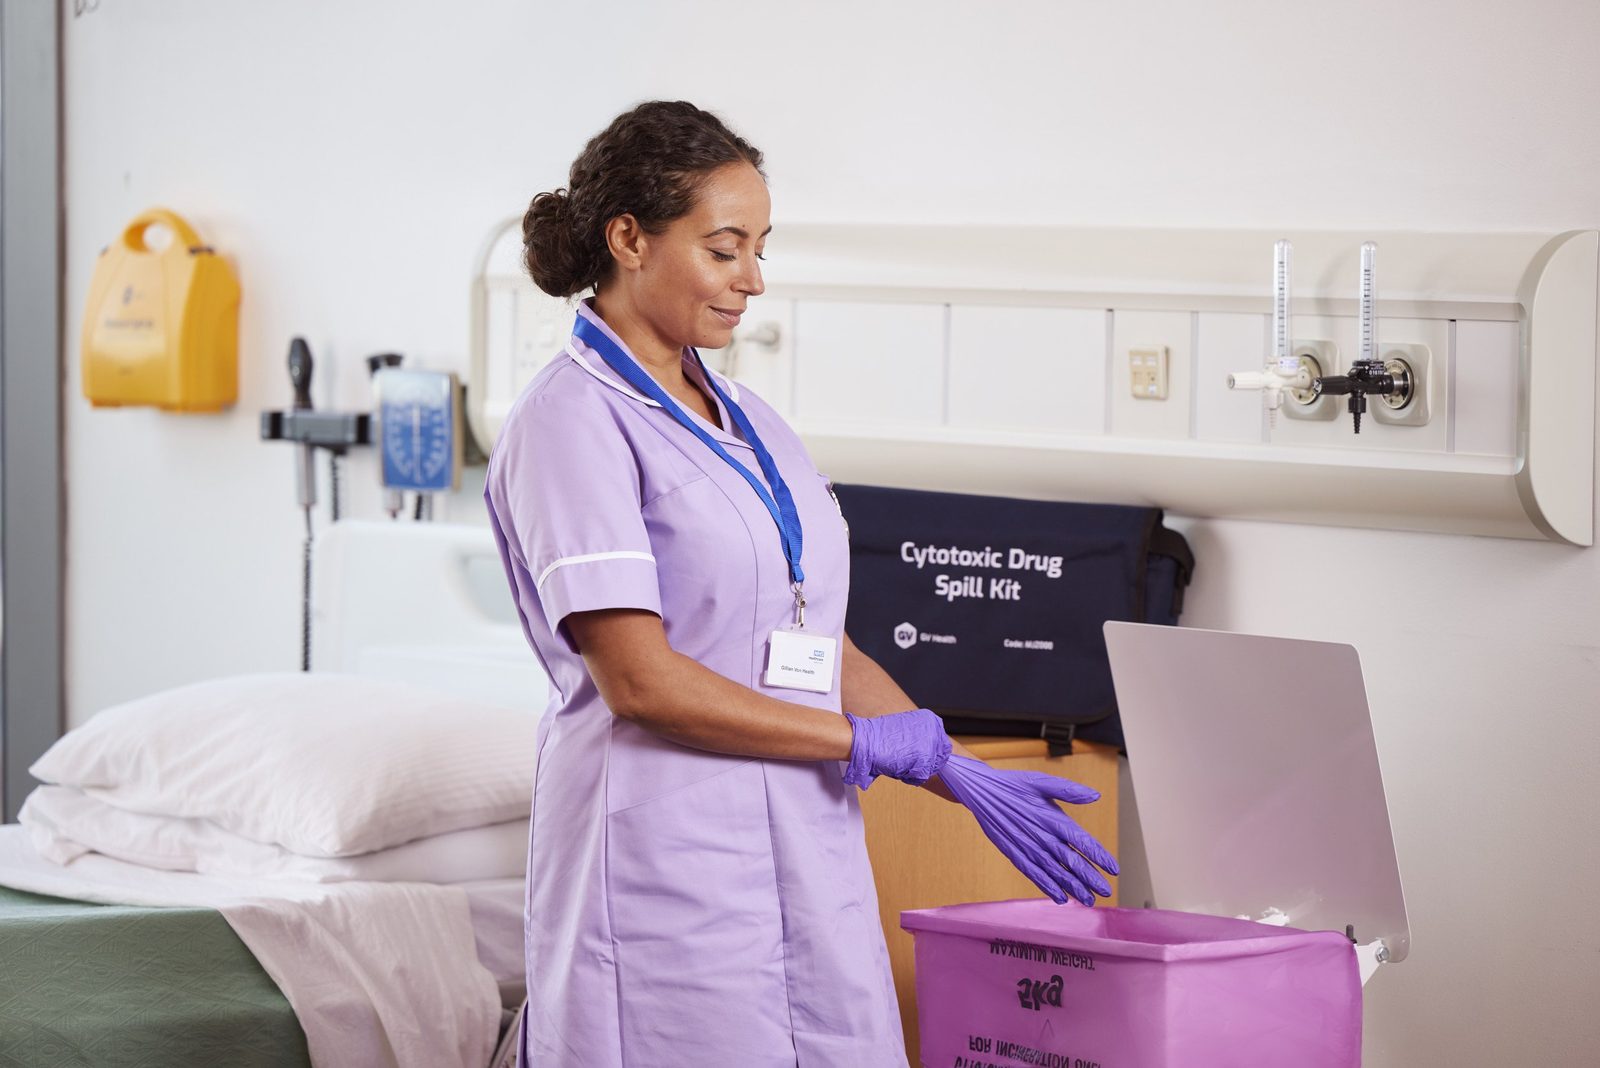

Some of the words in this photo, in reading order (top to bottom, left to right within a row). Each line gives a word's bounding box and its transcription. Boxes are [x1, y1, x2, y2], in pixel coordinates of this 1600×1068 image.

[900, 541, 1002, 569] Cytotoxic
[1008, 548, 1063, 578] Drug
[935, 574, 984, 602] Spill
[990, 577, 1022, 600] Kit
[898, 630, 914, 641] GV
